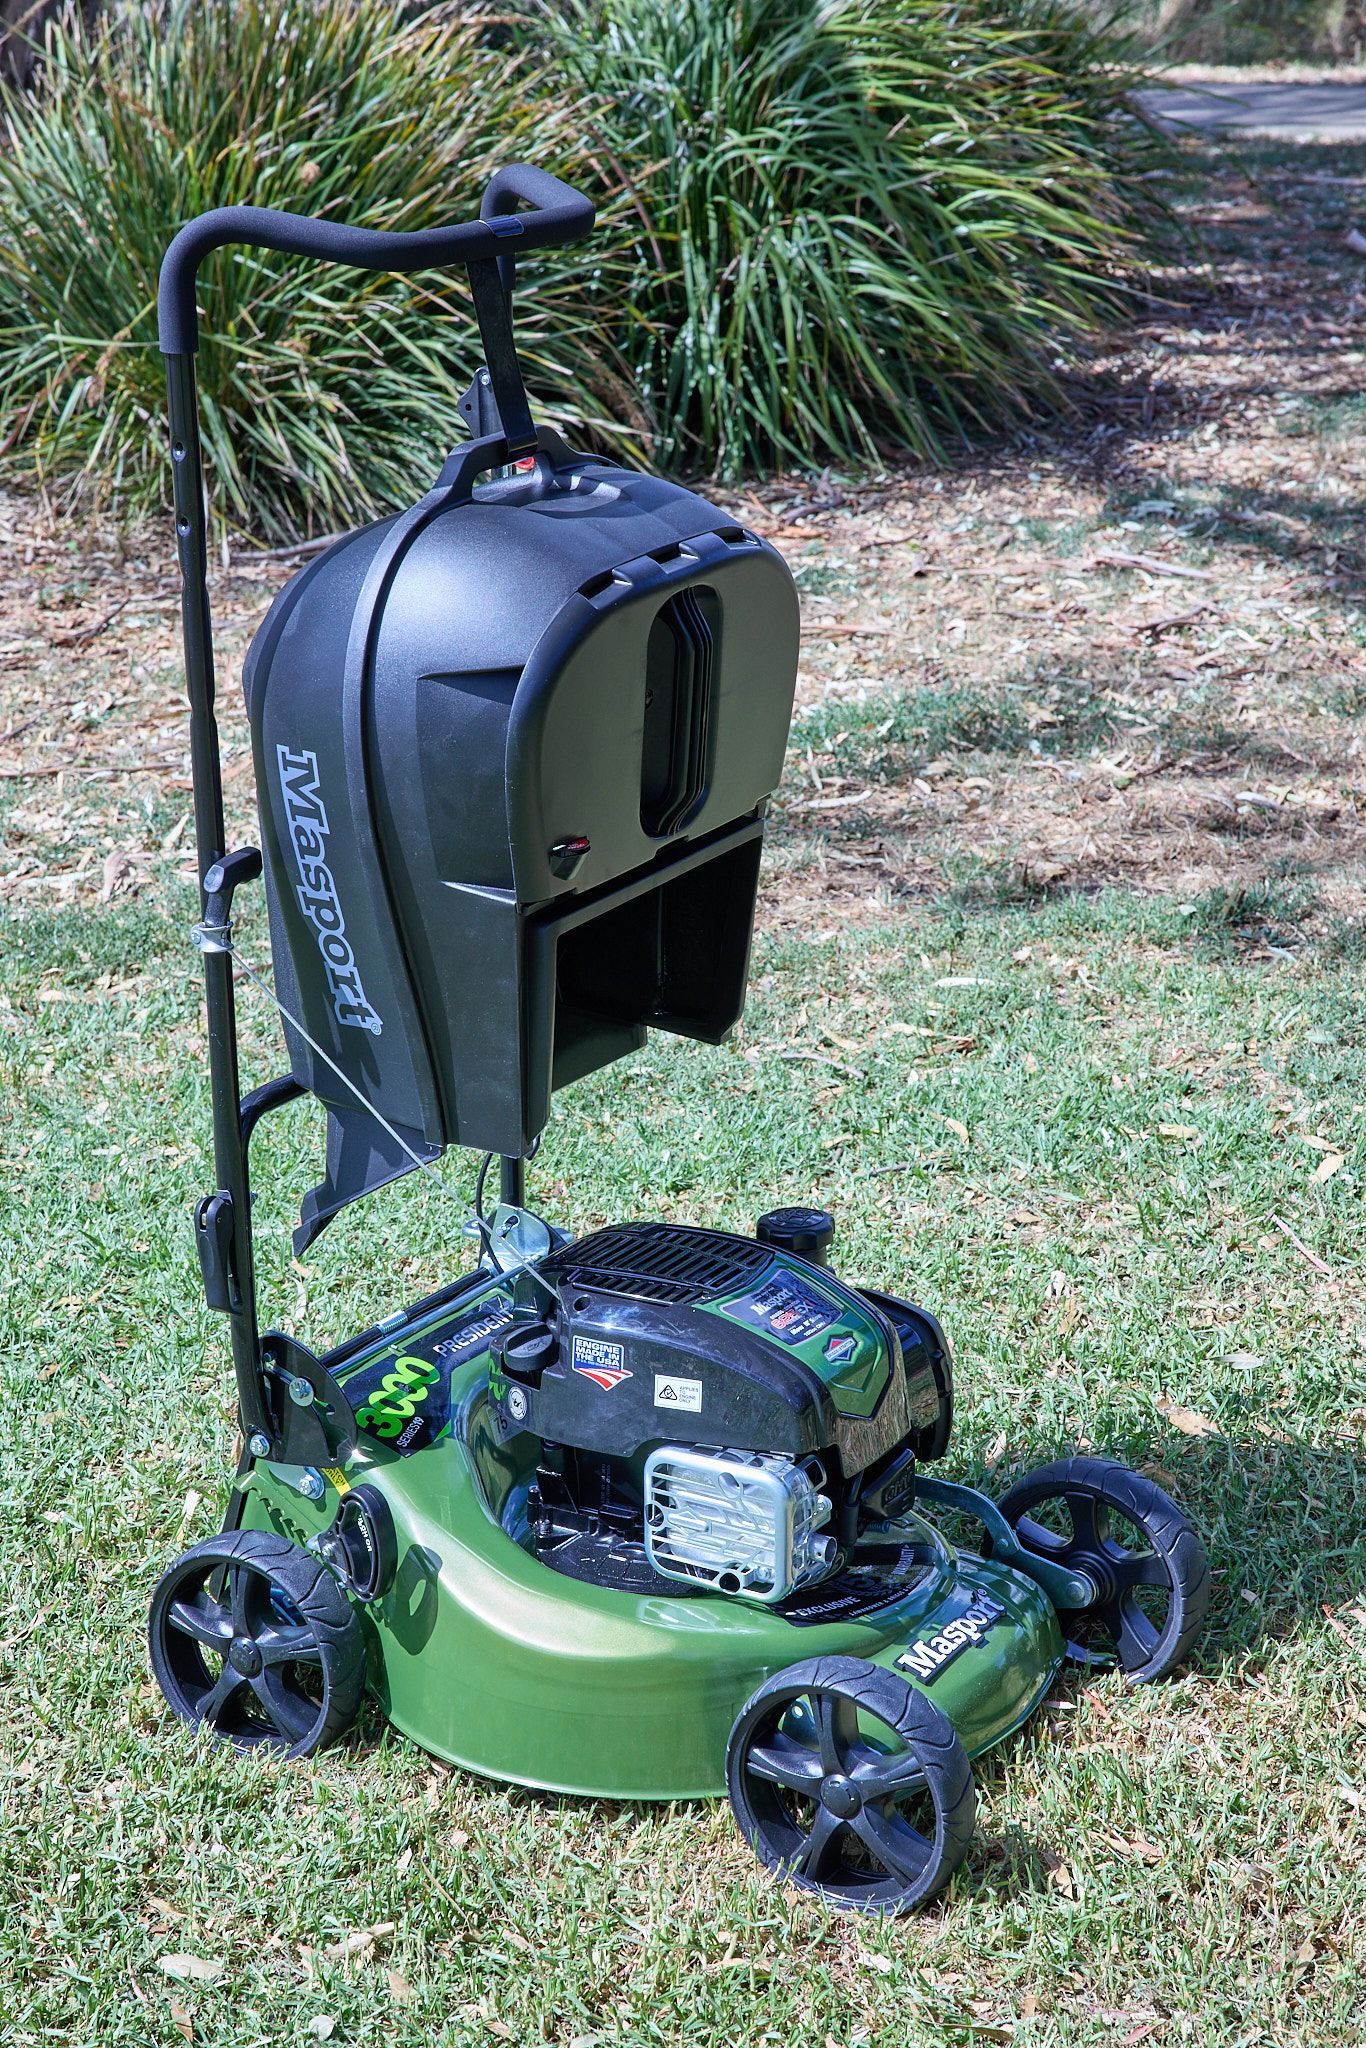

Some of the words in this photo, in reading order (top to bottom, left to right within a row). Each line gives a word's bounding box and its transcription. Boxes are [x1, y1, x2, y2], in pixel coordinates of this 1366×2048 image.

[276, 744, 384, 1034] Masport
[433, 1303, 514, 1357] PRESIDENT
[576, 1339, 620, 1354] ENGINE
[575, 1351, 595, 1362] THE
[597, 1356, 620, 1367] USA
[576, 1345, 605, 1358] MADE
[608, 1352, 620, 1361] IN
[355, 1356, 441, 1438] 3000
[798, 1595, 861, 1617] EXCLUSIVE
[896, 1594, 1005, 1678] Masport
